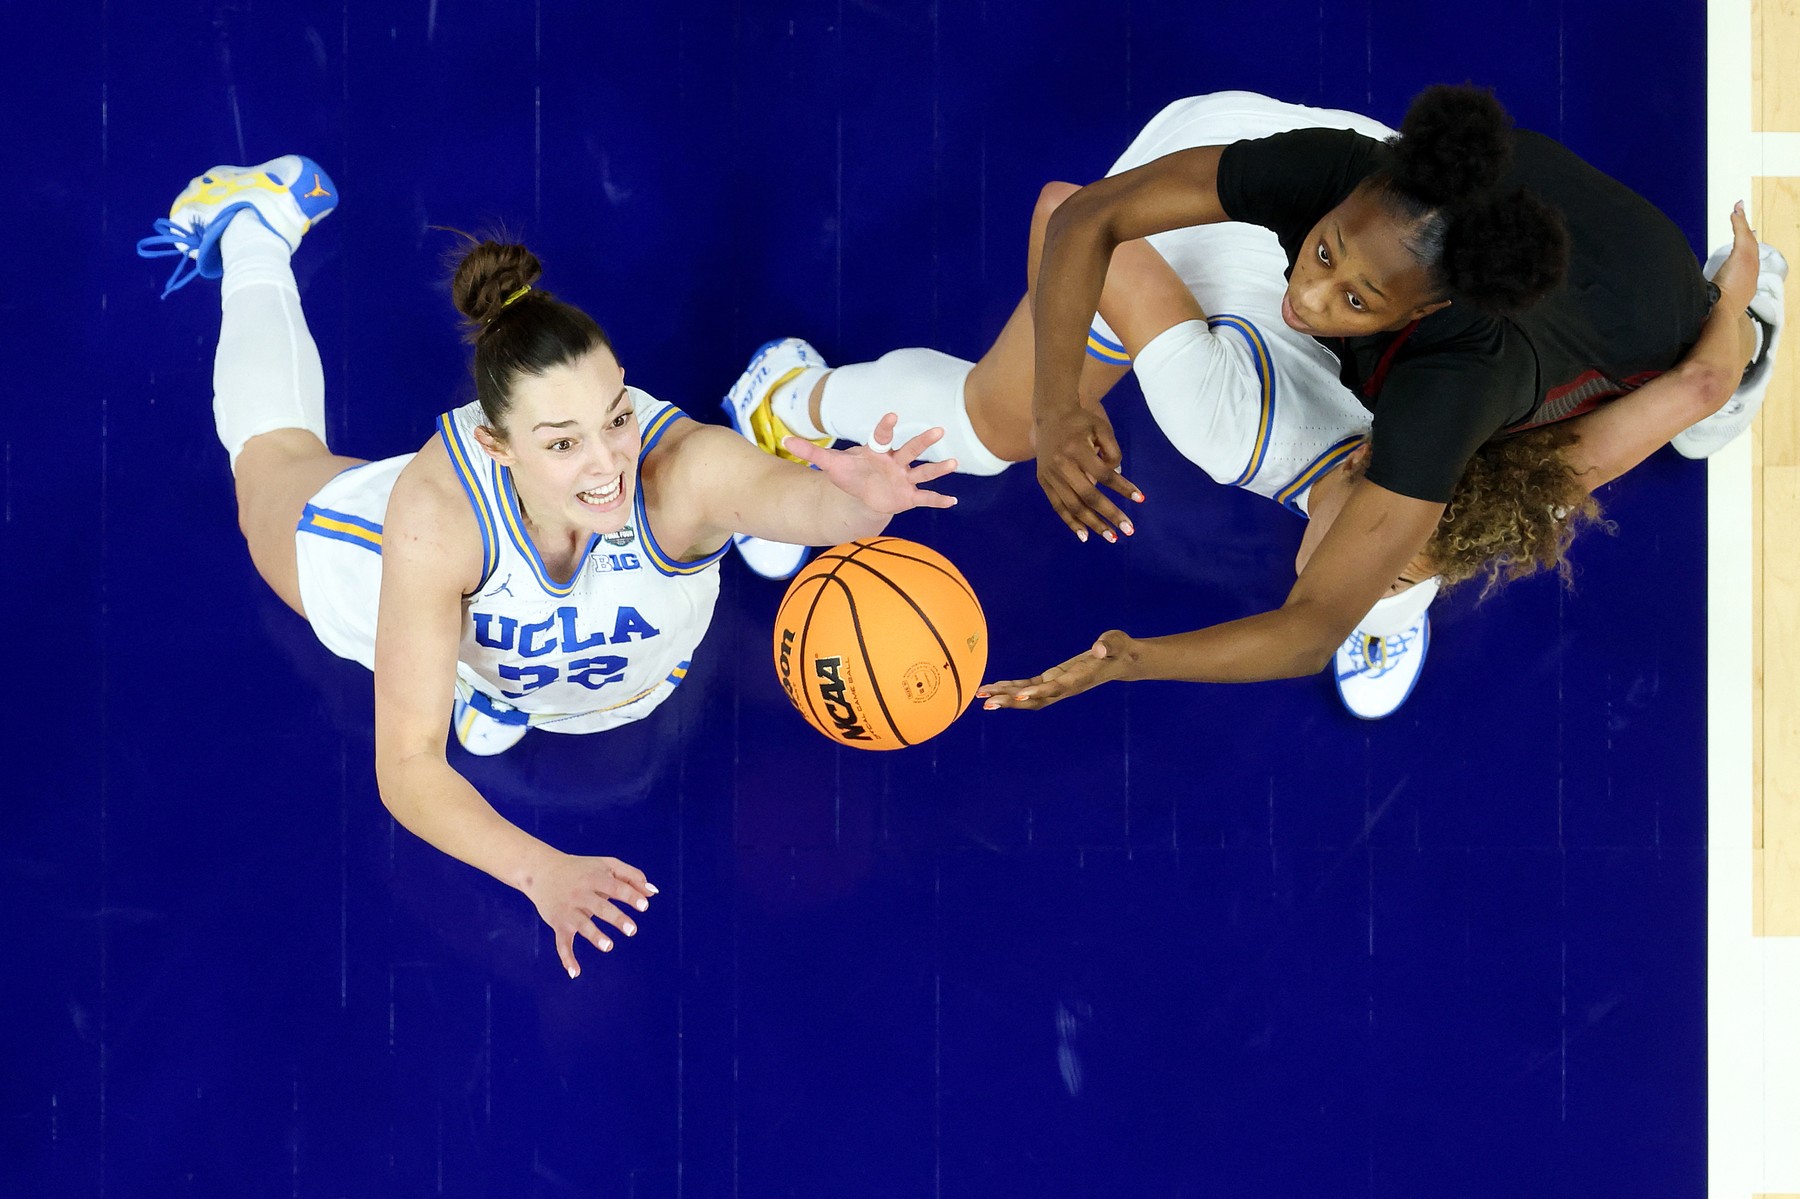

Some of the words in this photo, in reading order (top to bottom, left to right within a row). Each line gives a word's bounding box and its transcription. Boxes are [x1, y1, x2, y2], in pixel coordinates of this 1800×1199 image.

[473, 606, 660, 658] UCLA
[845, 657, 854, 684] BALL
[815, 656, 874, 741] NCAA
